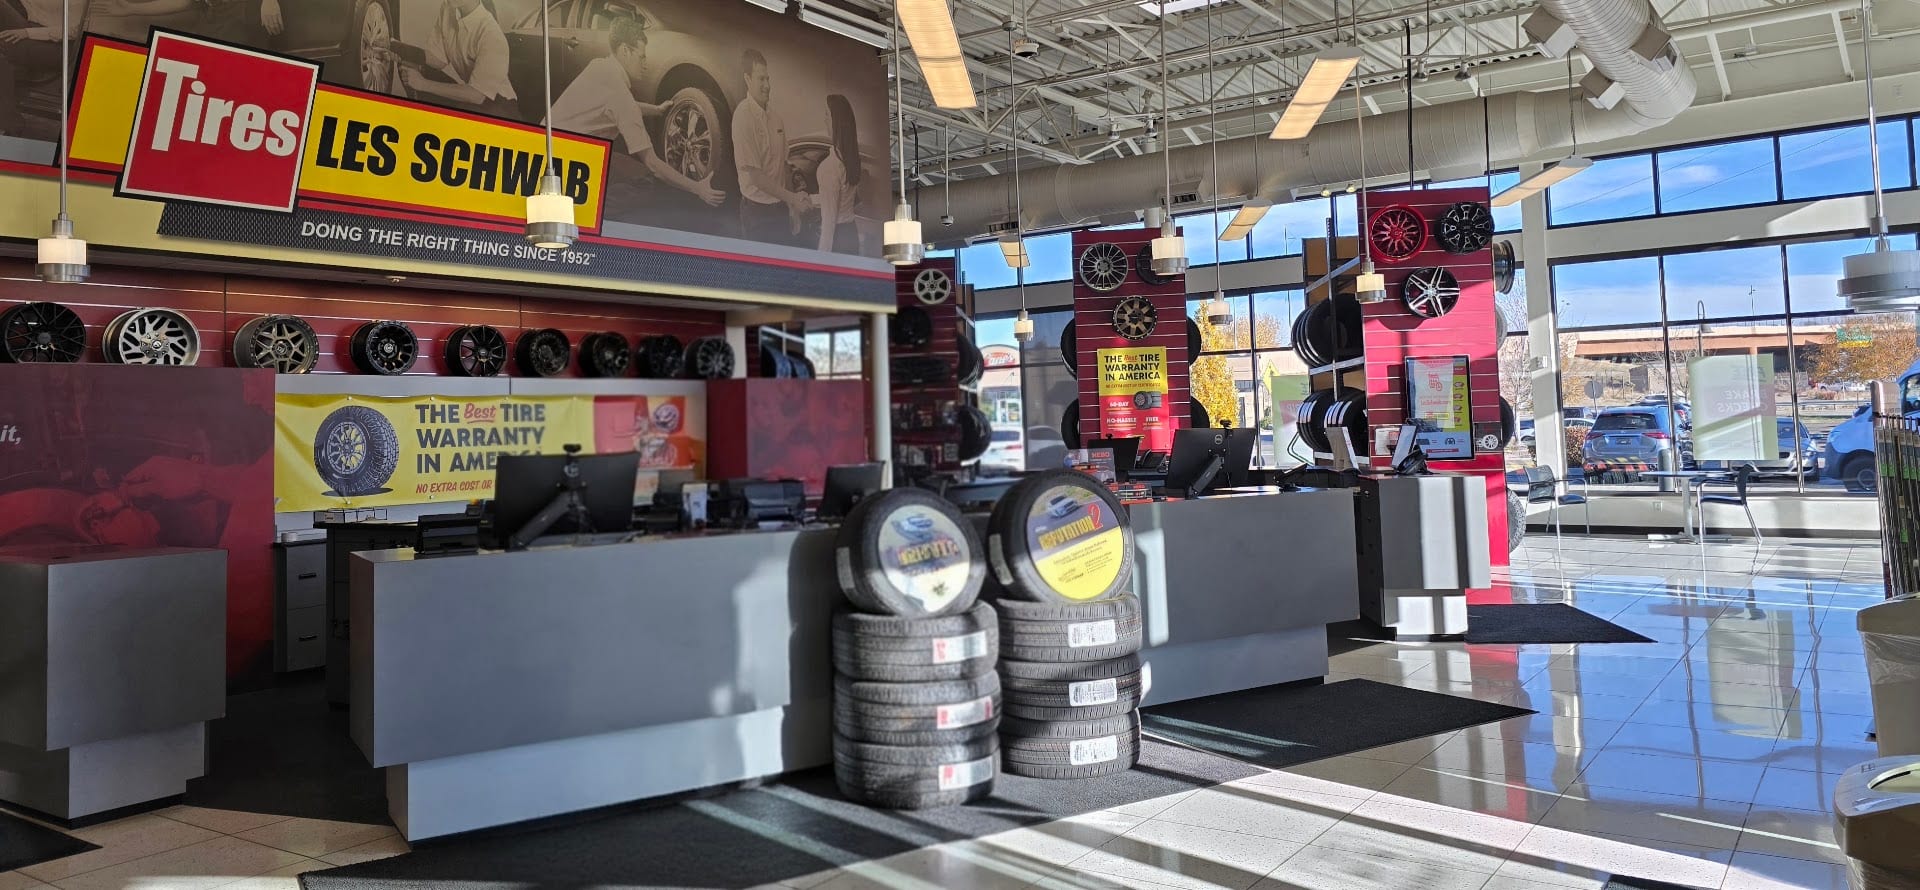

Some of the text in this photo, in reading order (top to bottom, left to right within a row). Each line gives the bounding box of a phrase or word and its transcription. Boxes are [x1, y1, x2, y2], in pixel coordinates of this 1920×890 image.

[151, 57, 300, 157] Tires
[315, 115, 399, 177] LES
[301, 221, 362, 242] DOING
[368, 228, 403, 246] THE
[407, 232, 460, 252] RIGHT
[463, 239, 509, 258] THING
[513, 245, 557, 262] SINCE
[1103, 354, 1122, 363] THE
[1139, 353, 1160, 362] TIRE
[1105, 362, 1160, 371] WARRANTY
[1119, 371, 1160, 380] AMERICA
[415, 403, 545, 424] THE Best TIRE
[416, 426, 545, 449] WARRANTY
[416, 453, 441, 474] IN
[416, 480, 493, 494] NO EXTRA COST OR
[1087, 503, 1104, 530] 2
